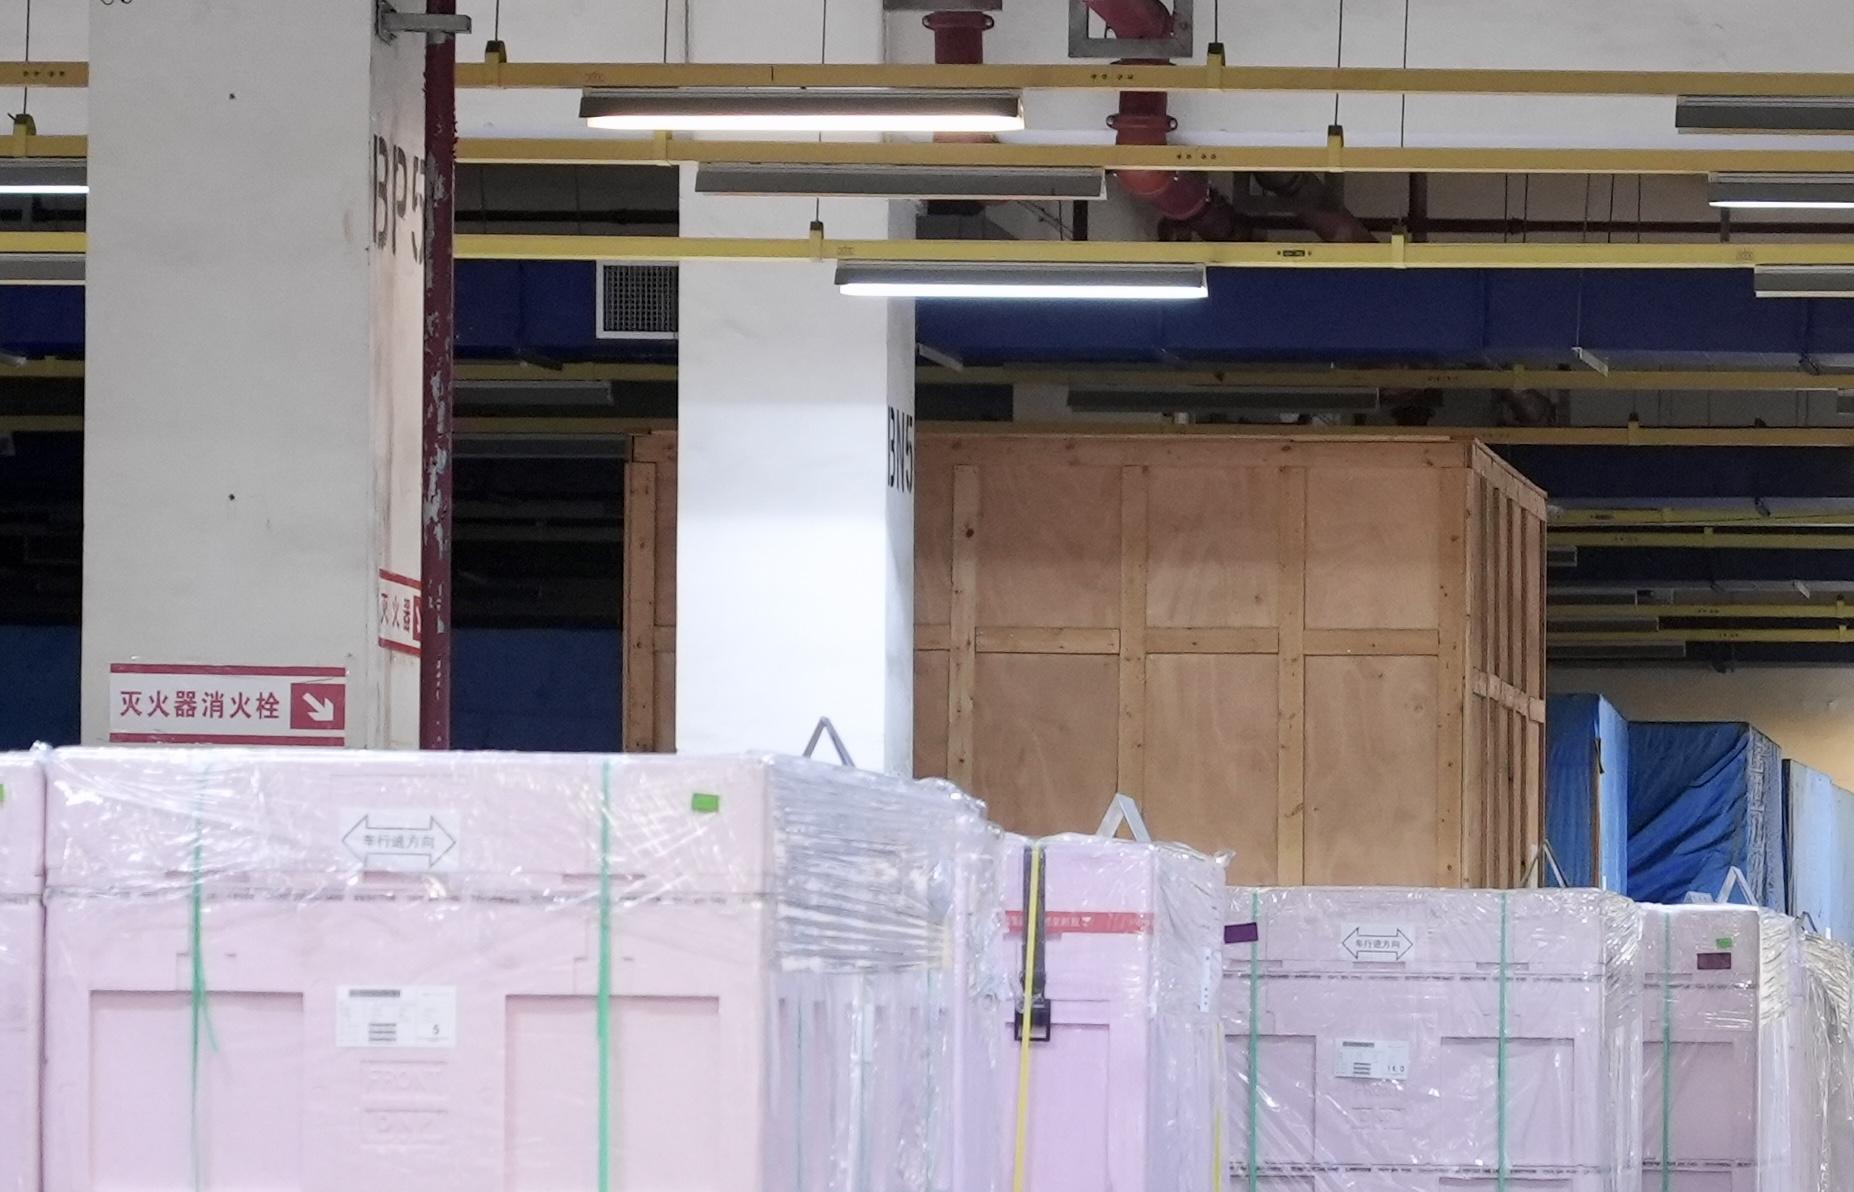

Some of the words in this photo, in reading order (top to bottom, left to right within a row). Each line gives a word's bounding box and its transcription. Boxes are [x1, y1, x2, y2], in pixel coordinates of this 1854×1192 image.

[887, 406, 913, 494] BN5
[119, 690, 280, 720] 灭火器消火栓
